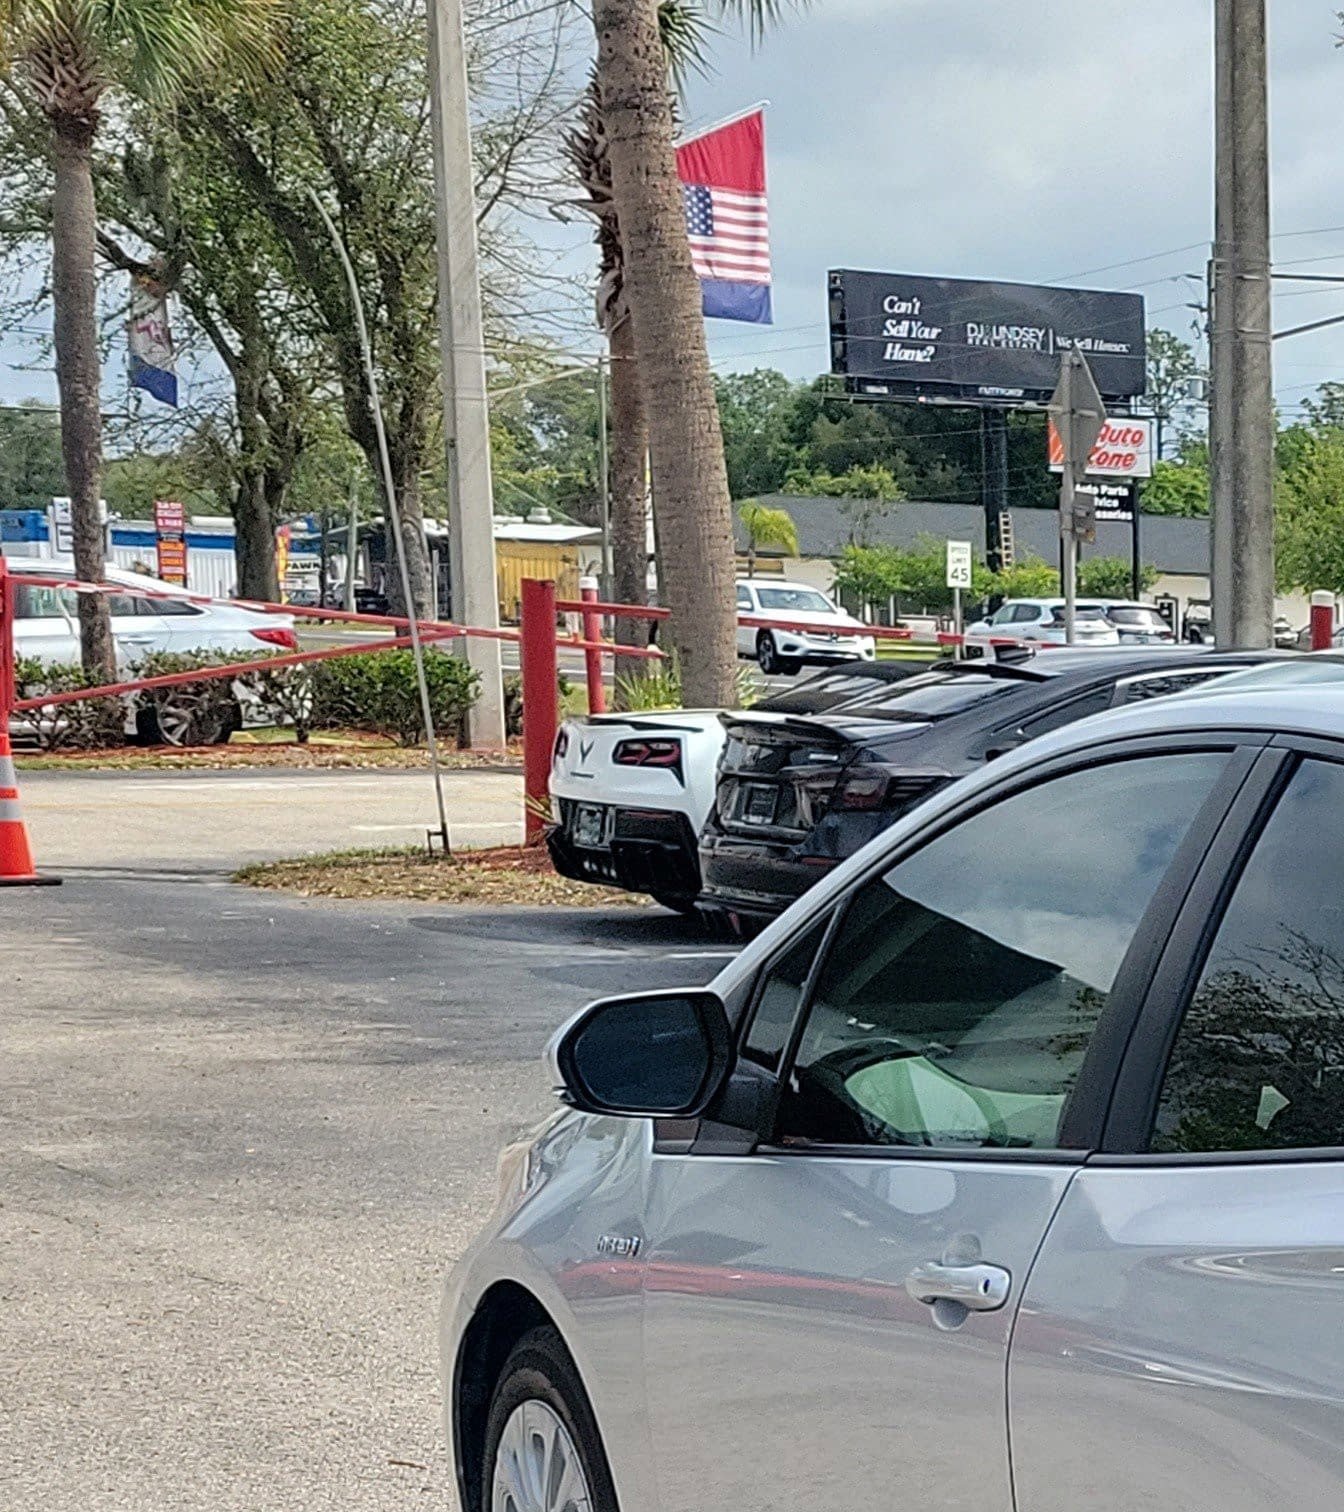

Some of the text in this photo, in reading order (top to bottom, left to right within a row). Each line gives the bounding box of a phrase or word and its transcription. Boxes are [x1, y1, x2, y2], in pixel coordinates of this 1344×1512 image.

[883, 295, 921, 315] Can't
[882, 319, 942, 340] Sell Your
[967, 323, 984, 338] DJ
[993, 323, 1046, 342] LINDSEY
[883, 343, 935, 362] Home?
[1075, 483, 1129, 497] Auto Parts
[951, 567, 969, 582] 45
